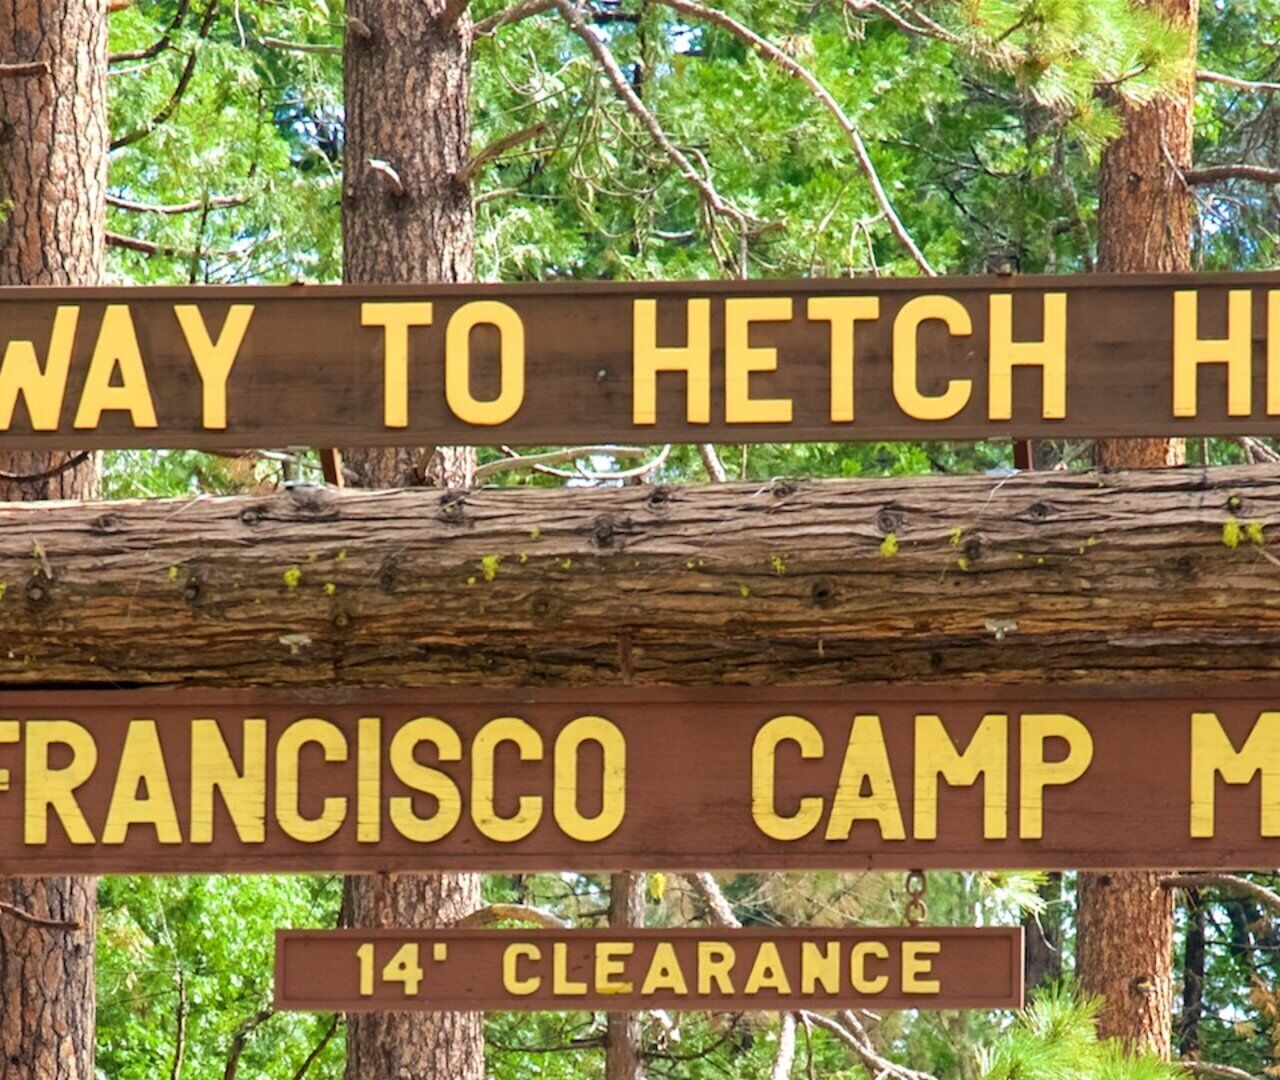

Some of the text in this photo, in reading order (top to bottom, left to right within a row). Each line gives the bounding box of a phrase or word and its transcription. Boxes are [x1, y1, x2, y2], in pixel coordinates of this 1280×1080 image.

[360, 300, 526, 428] TO
[632, 292, 1068, 426] HETCH
[750, 713, 1095, 842] CAMP
[355, 940, 942, 996] 14' CLEARANCE
